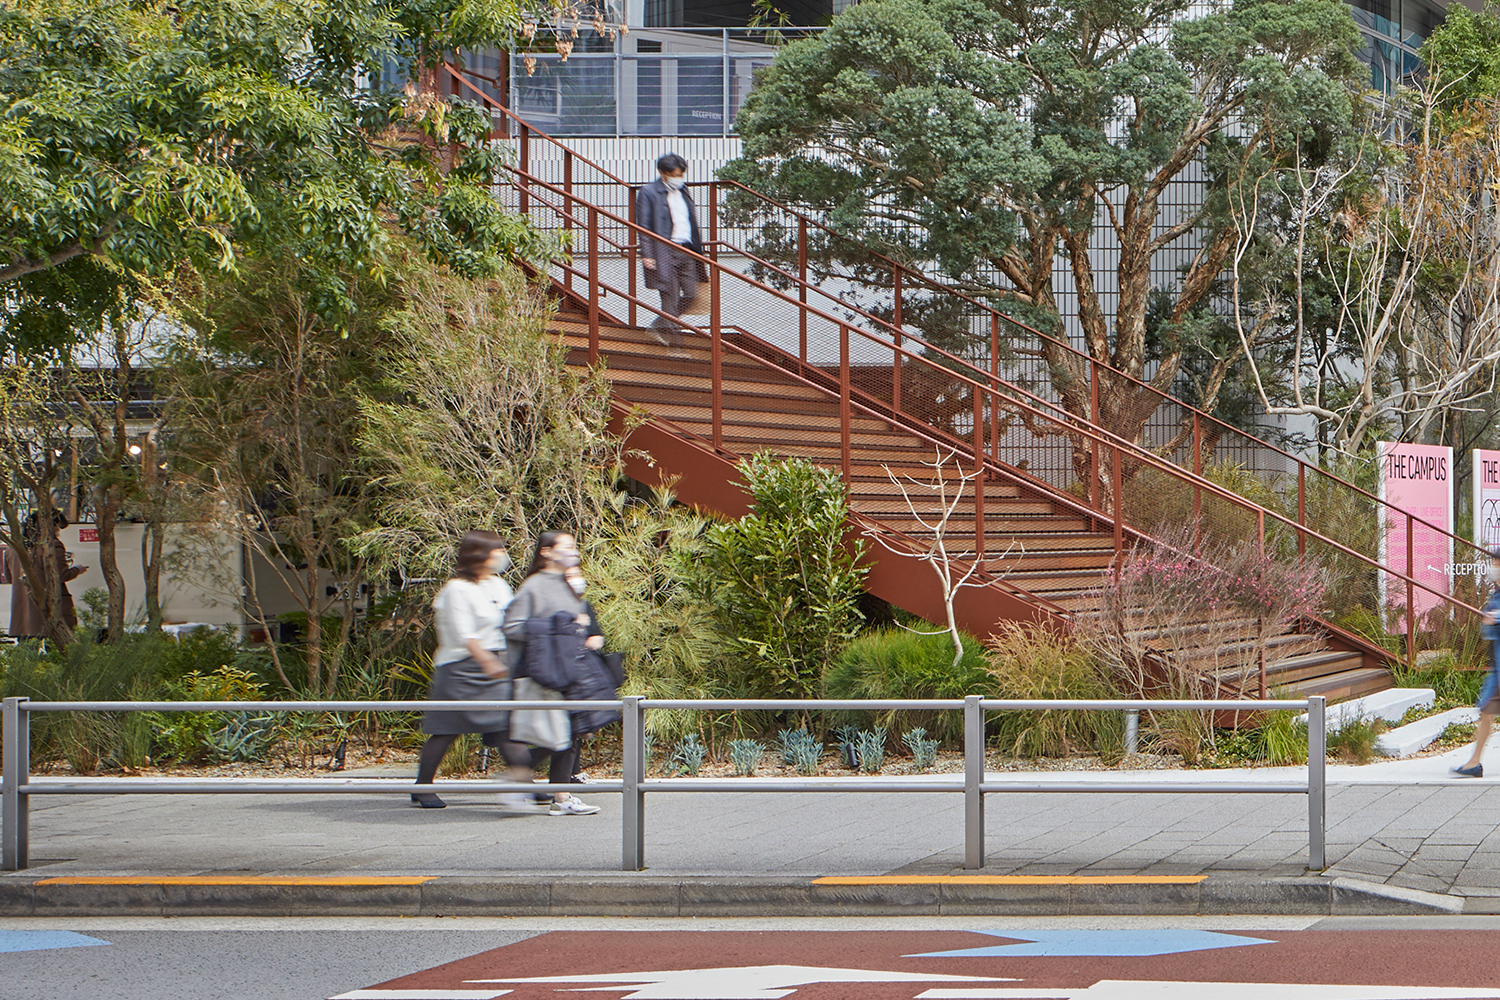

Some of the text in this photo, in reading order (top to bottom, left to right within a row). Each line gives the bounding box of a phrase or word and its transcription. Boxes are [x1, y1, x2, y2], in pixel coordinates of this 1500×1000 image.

[1388, 454, 1447, 481] THE CAMPUS
[1482, 460, 1499, 483] THE
